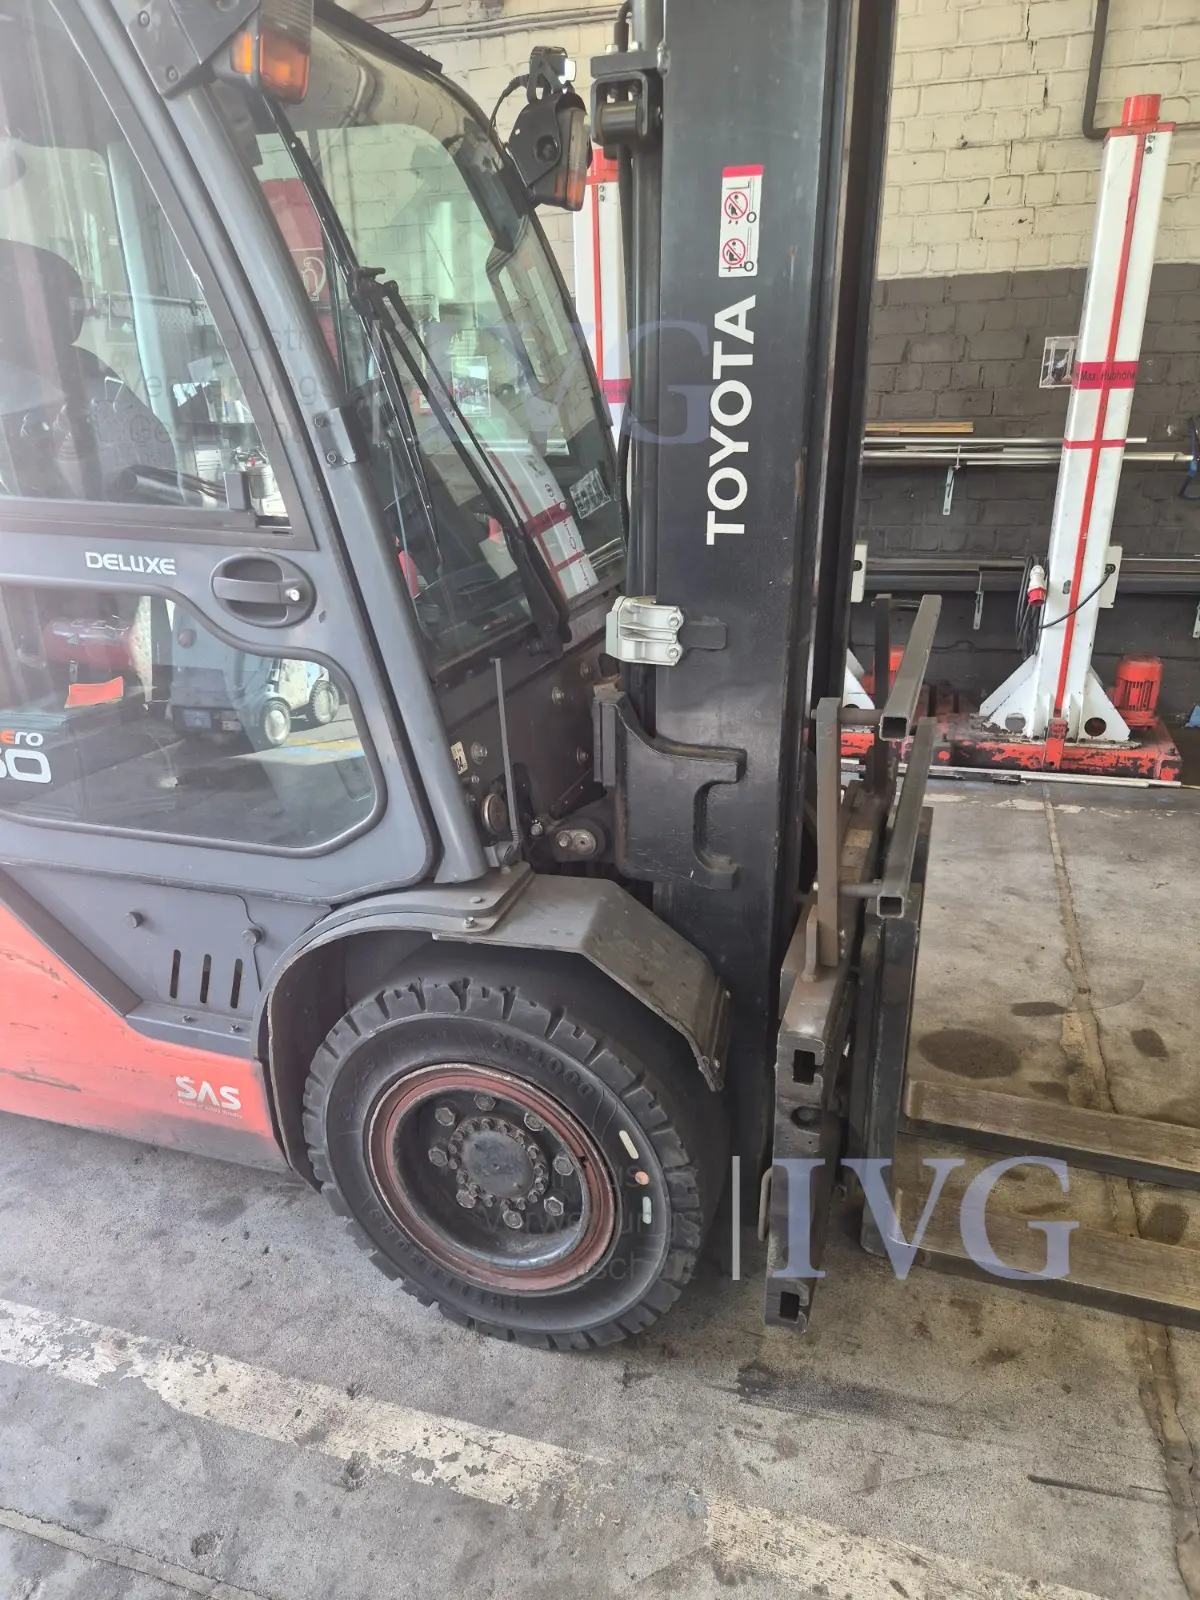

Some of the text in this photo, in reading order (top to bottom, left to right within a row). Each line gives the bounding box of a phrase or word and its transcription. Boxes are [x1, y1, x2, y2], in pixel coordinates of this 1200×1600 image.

[706, 295, 756, 545] TOYOTA
[84, 551, 177, 576] DELUXE
[0, 747, 52, 784] 0
[175, 1075, 242, 1110] SAS
